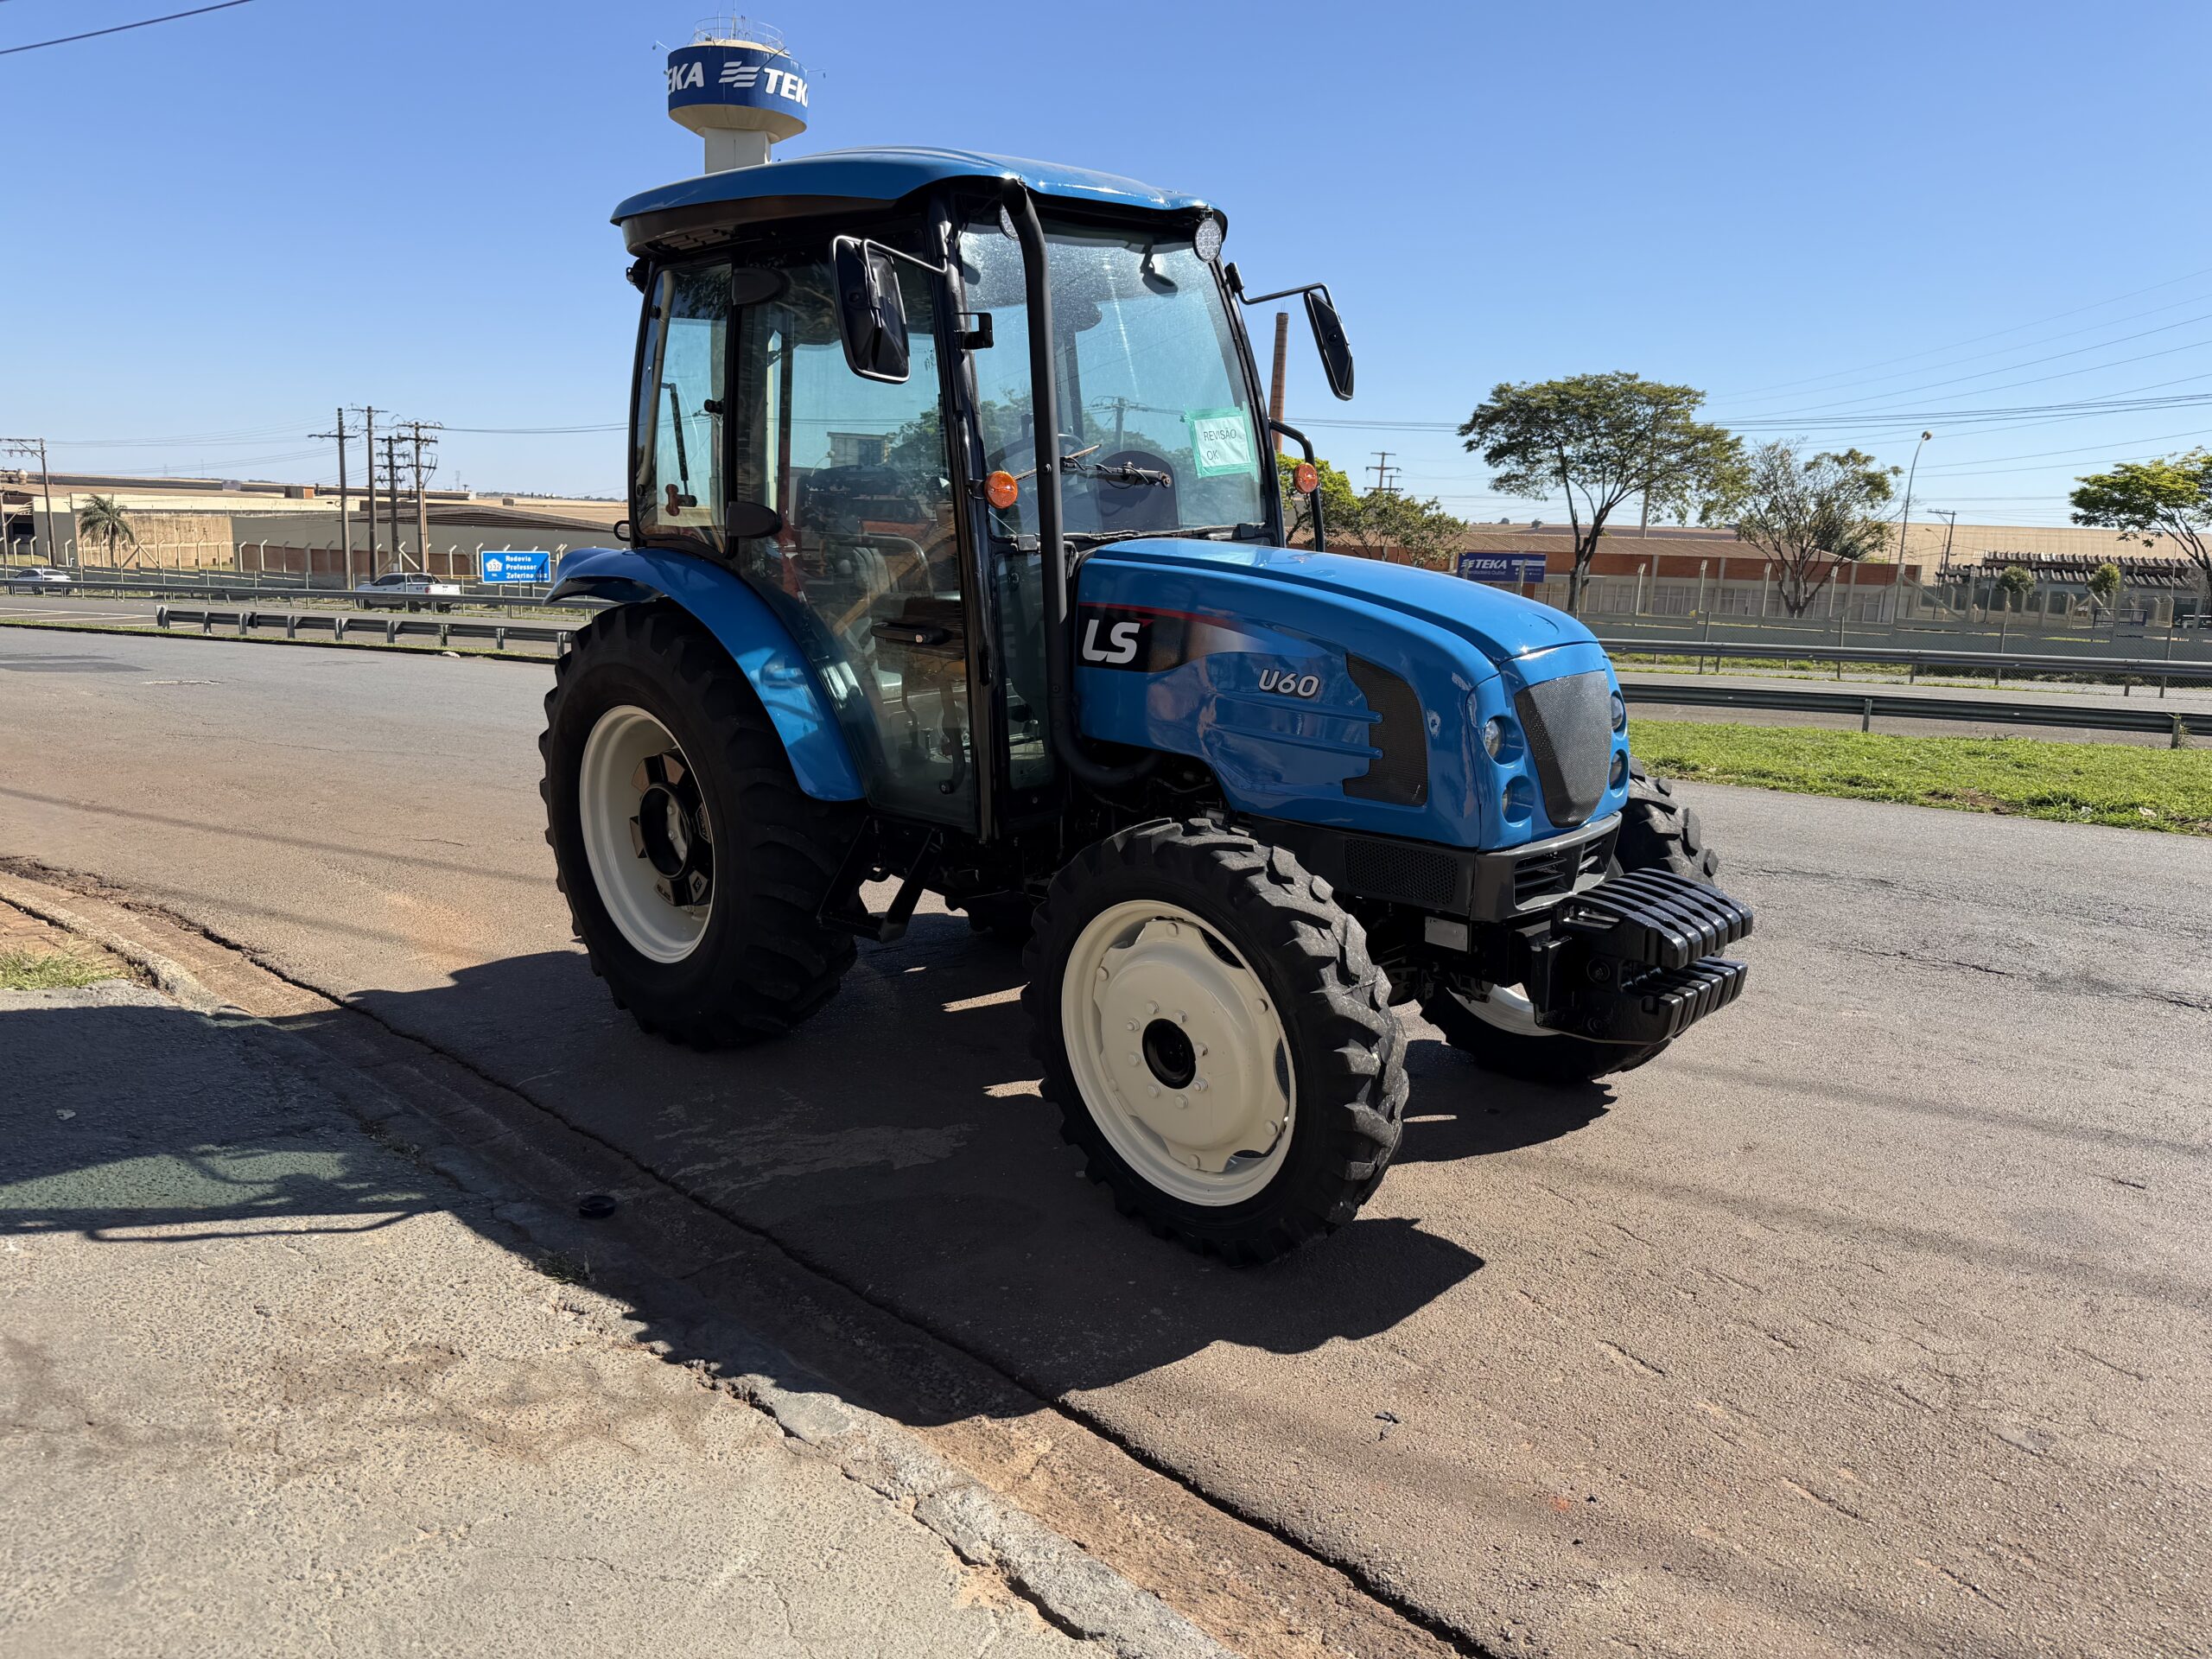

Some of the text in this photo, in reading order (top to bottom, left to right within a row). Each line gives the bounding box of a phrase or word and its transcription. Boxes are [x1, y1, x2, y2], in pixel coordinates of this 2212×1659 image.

[764, 67, 808, 108] TEK
[1203, 428, 1236, 442] REVISÃO
[1206, 450, 1219, 461] OK
[1475, 558, 1507, 569] TEKA
[1082, 619, 1141, 664] LS
[1258, 669, 1319, 697] U60
